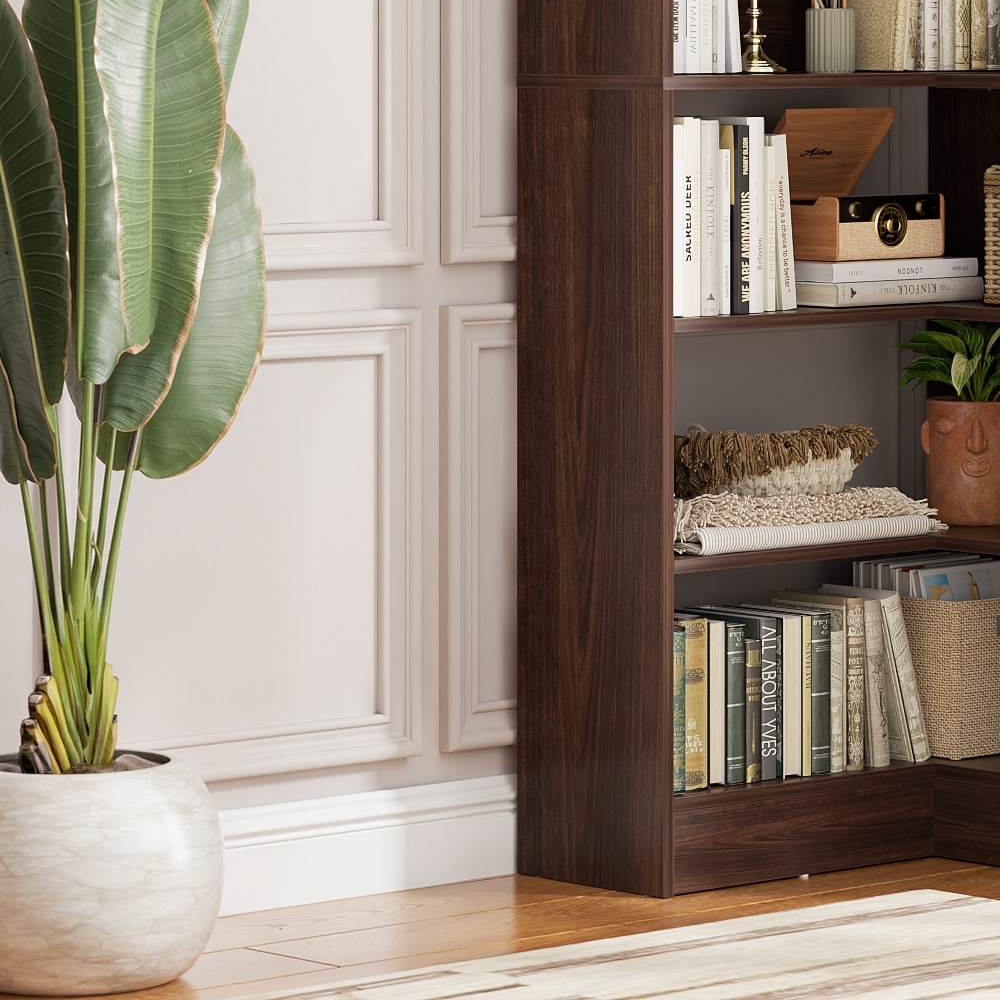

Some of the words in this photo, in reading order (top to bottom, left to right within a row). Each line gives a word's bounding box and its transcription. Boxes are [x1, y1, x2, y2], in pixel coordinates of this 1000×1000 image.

[741, 192, 750, 258] ANONYMOUS
[741, 262, 750, 282] ARE
[784, 258, 789, 266] be
[742, 285, 750, 302] WE
[897, 284, 937, 295] KINFOLK
[762, 626, 776, 654] ALL
[762, 659, 776, 711] ABOUT
[762, 718, 776, 757] YVES
